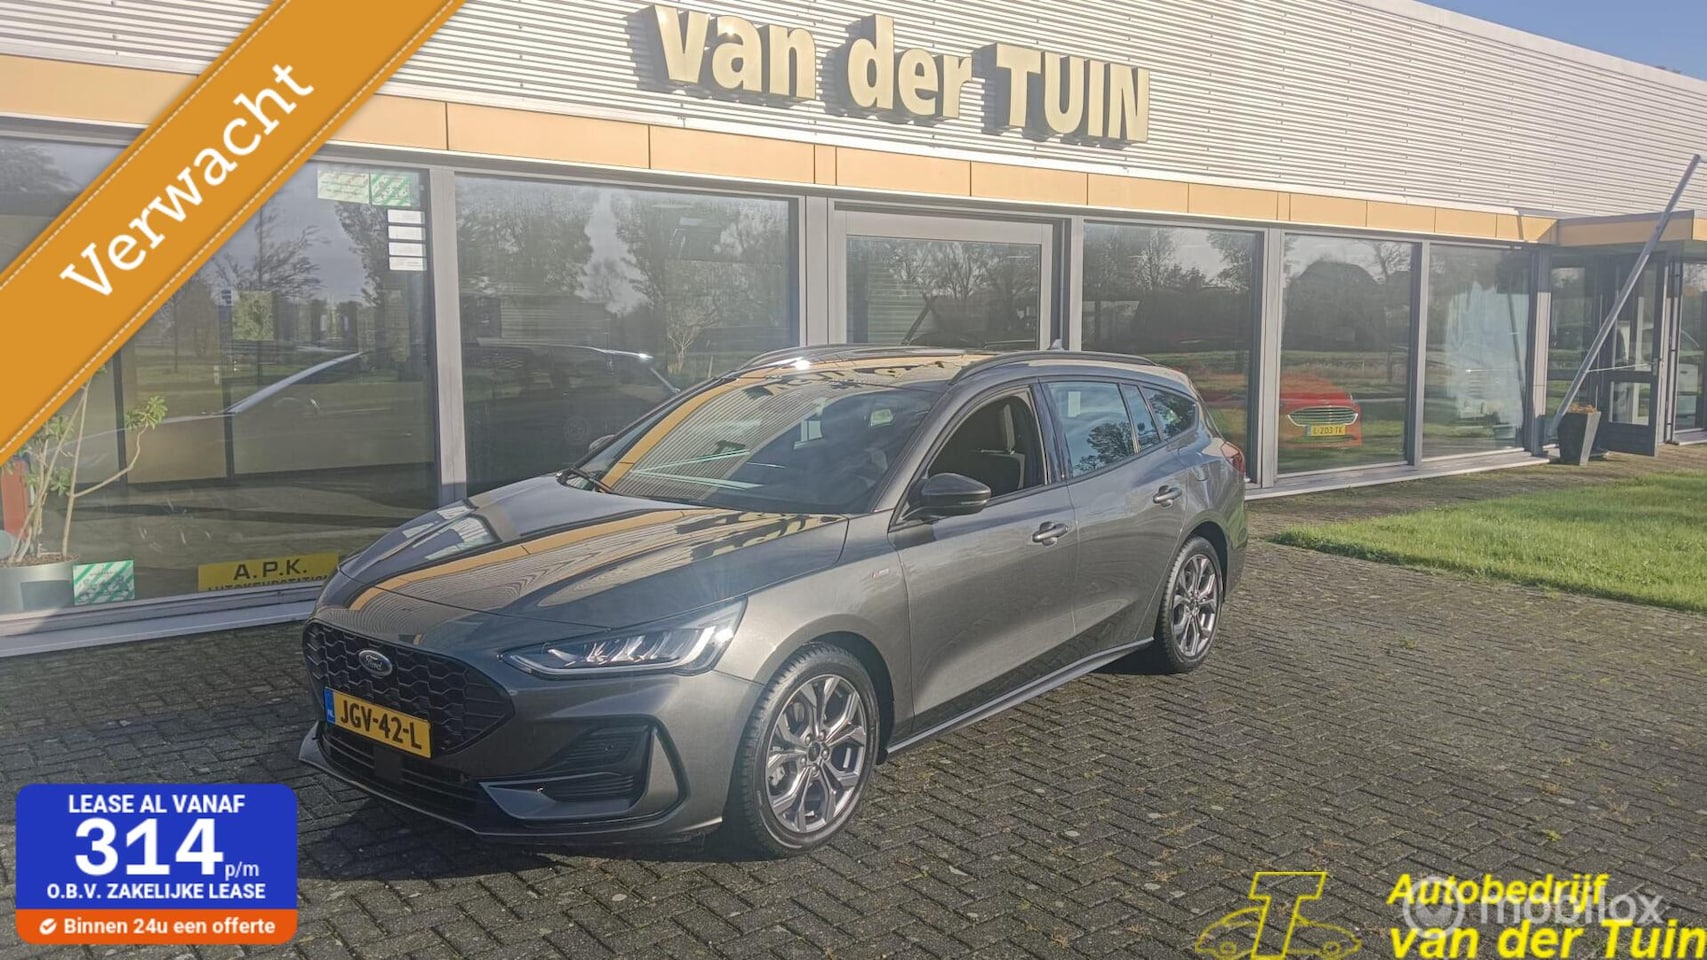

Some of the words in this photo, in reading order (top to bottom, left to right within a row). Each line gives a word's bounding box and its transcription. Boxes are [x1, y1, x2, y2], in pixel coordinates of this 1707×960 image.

[652, 4, 817, 101] van
[846, 14, 973, 120] der
[995, 43, 1150, 143] TUIN
[233, 559, 307, 580] A.P.K.
[340, 700, 422, 750] JGV-42-L
